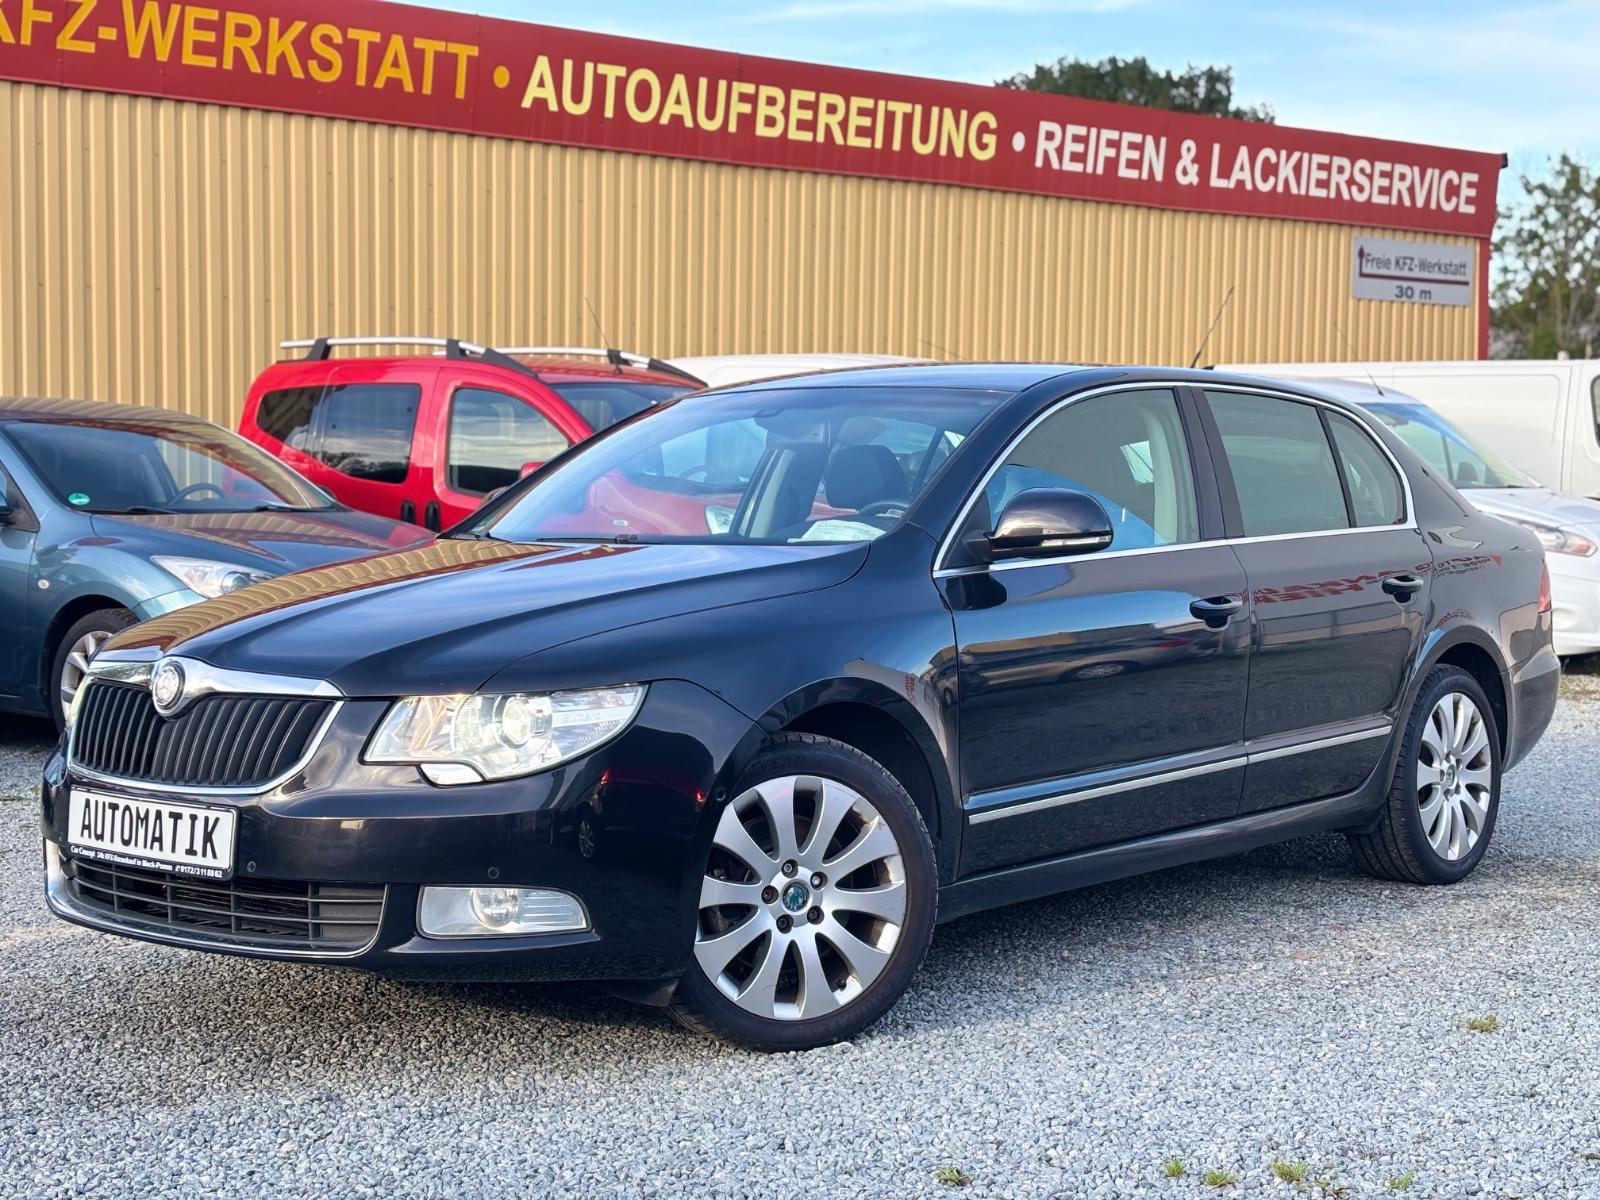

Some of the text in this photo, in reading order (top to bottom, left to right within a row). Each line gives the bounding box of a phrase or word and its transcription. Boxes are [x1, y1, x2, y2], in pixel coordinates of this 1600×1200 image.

[0, 0, 1480, 214] FZ-WERKSTATT AUTOAUFBEREITUNG REIFEN & LACKIERSERVICE
[1365, 253, 1467, 277] Freie KFZ-Werkstatt
[1395, 285, 1432, 300] 30 m
[80, 798, 220, 860] AUTOMATIK
